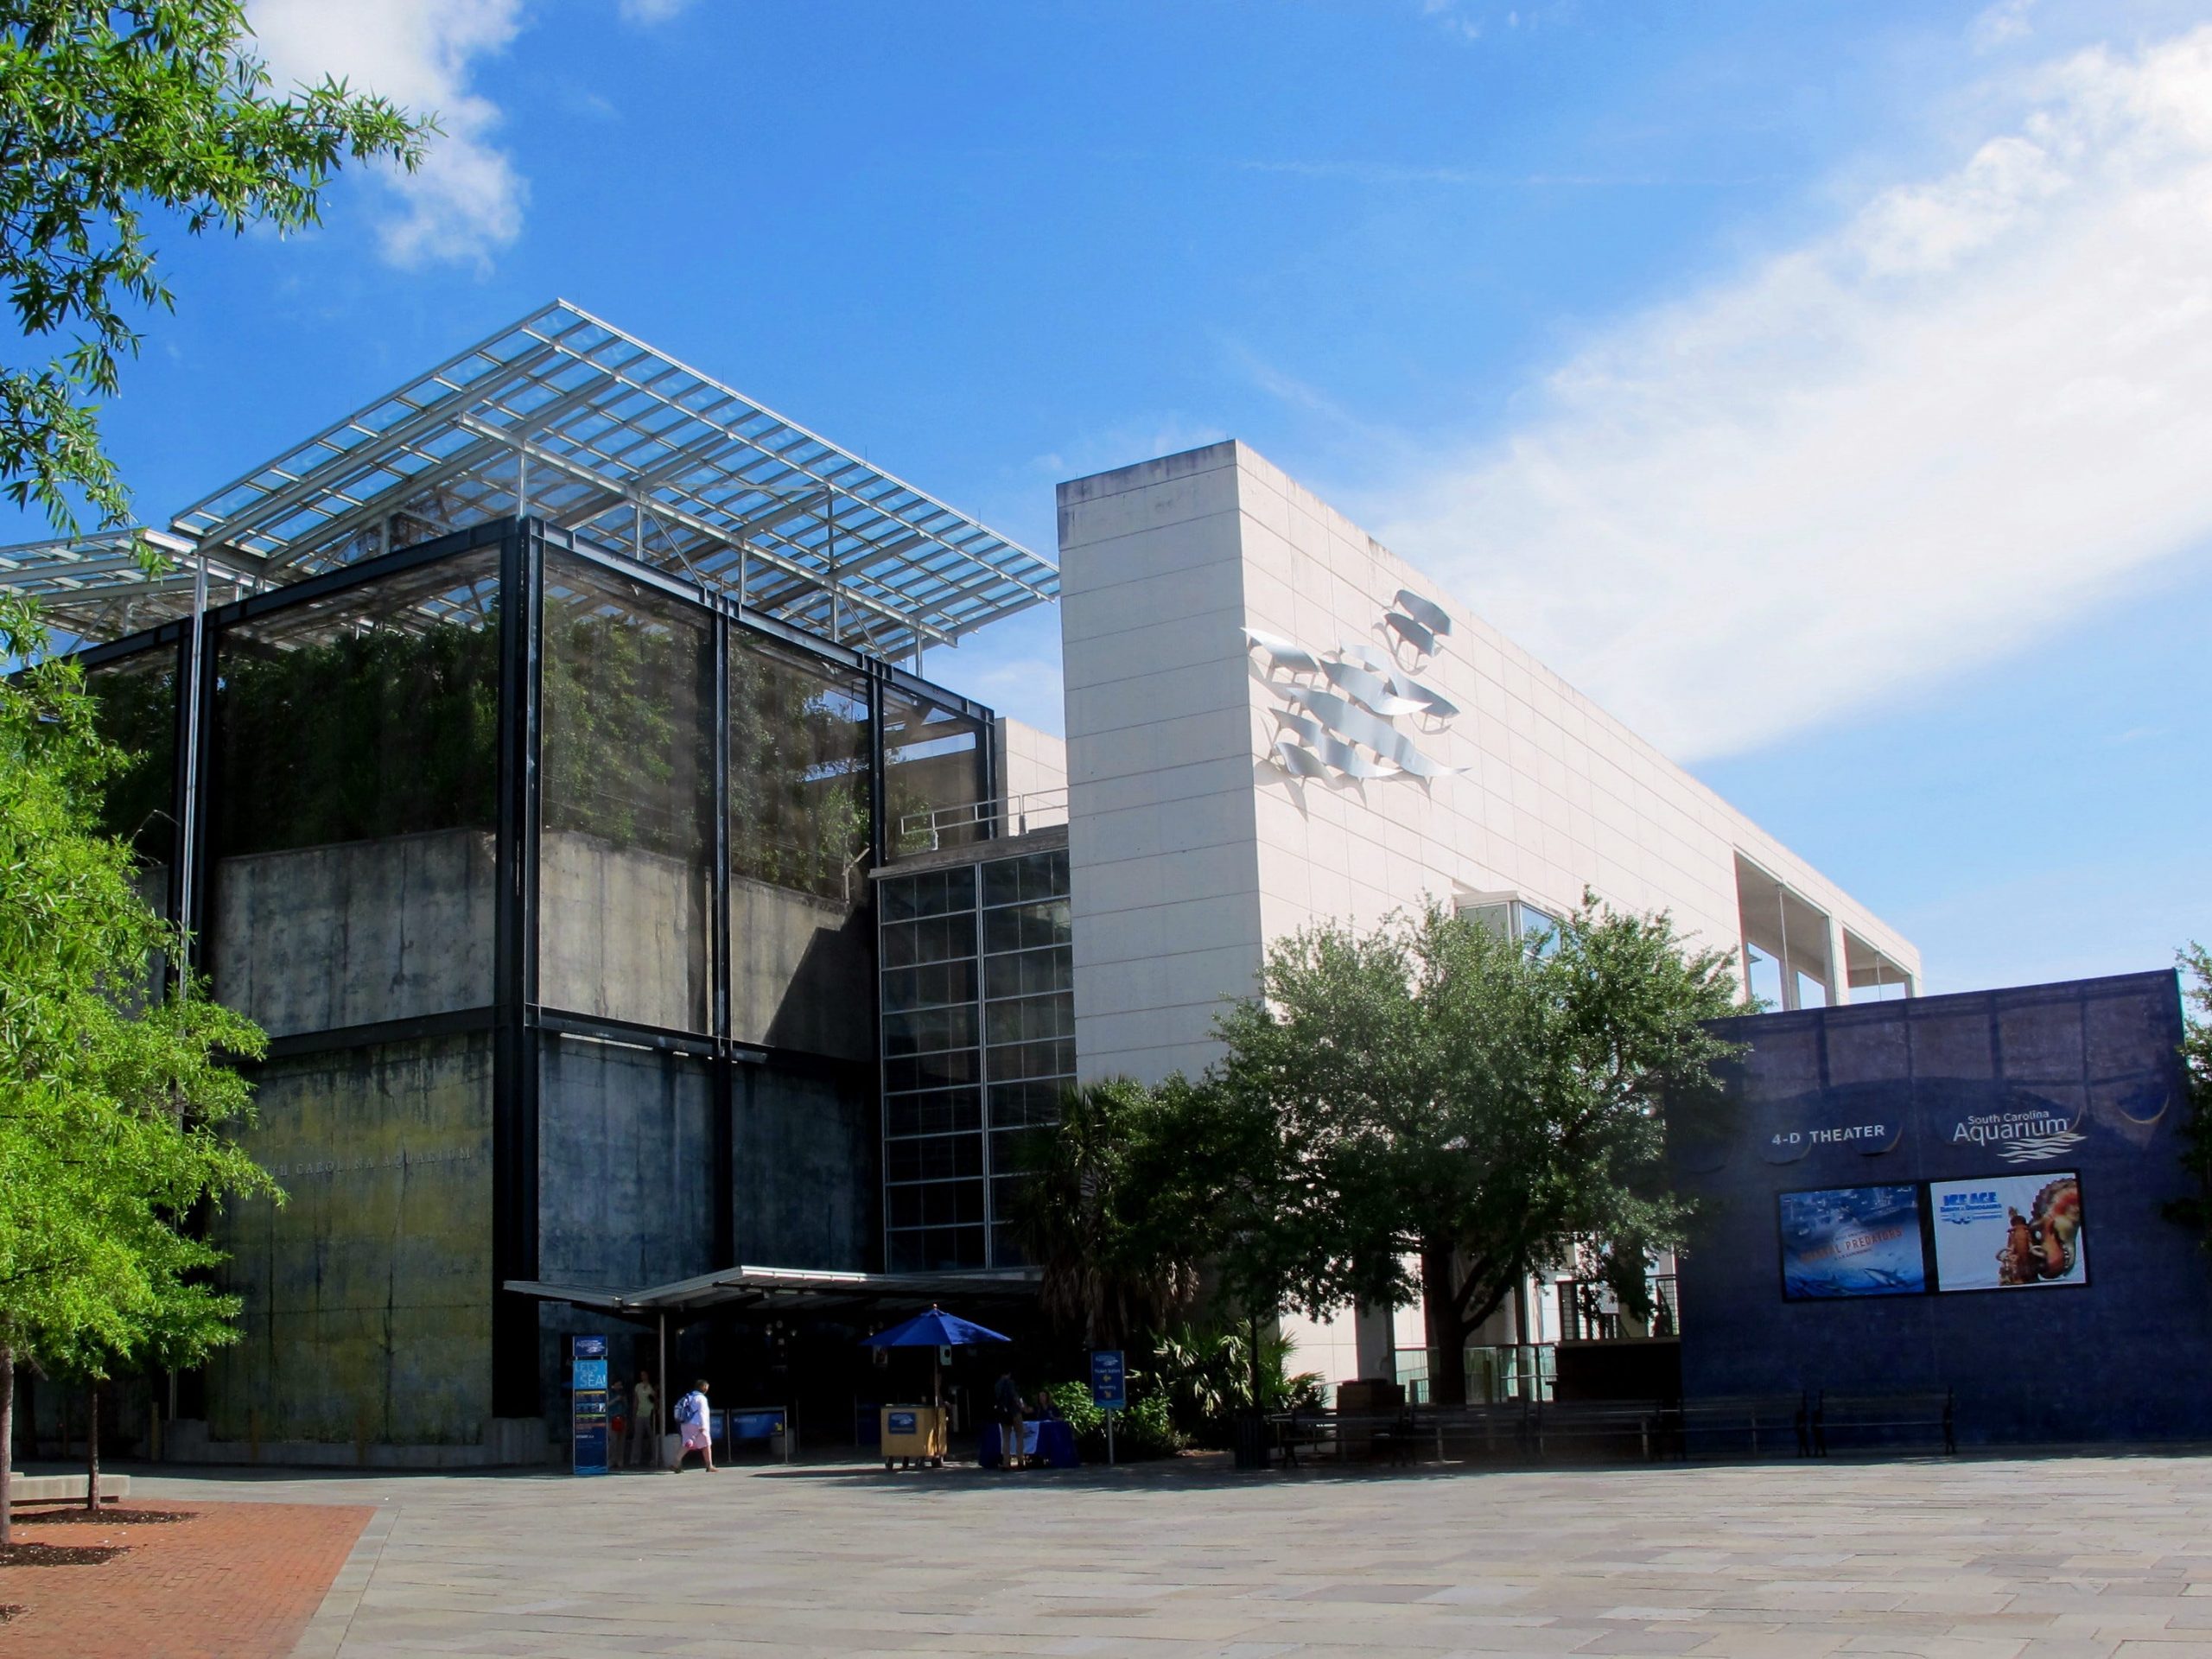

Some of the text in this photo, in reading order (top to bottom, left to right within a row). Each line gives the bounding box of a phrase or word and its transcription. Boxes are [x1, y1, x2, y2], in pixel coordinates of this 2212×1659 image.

[1967, 1110, 2050, 1125] South Carolina
[1771, 1125, 1885, 1145] 4-D THEATER
[1953, 1117, 2068, 1147] Aquarium
[1943, 1192, 1997, 1206] ICE AGE
